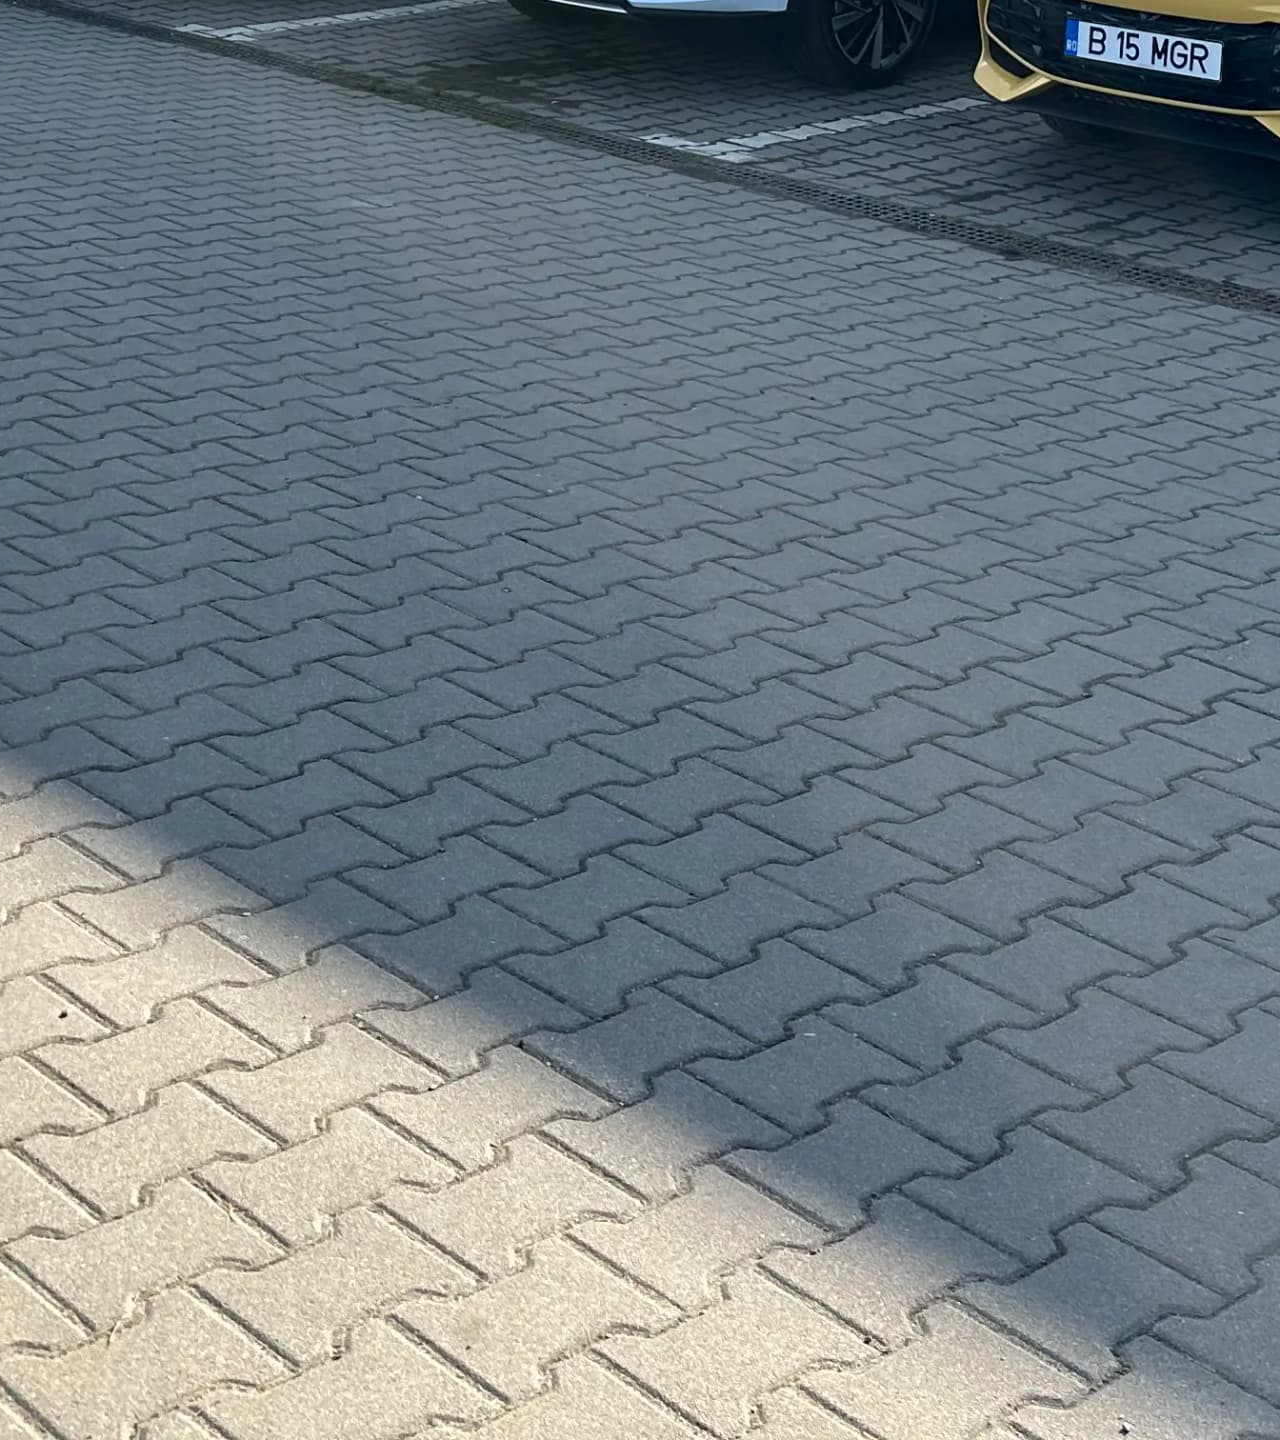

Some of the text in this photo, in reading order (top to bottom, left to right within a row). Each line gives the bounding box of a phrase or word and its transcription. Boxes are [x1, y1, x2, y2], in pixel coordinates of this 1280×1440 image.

[1088, 26, 1107, 55] B
[1116, 31, 1140, 61] 15
[1151, 36, 1209, 74] MGR
